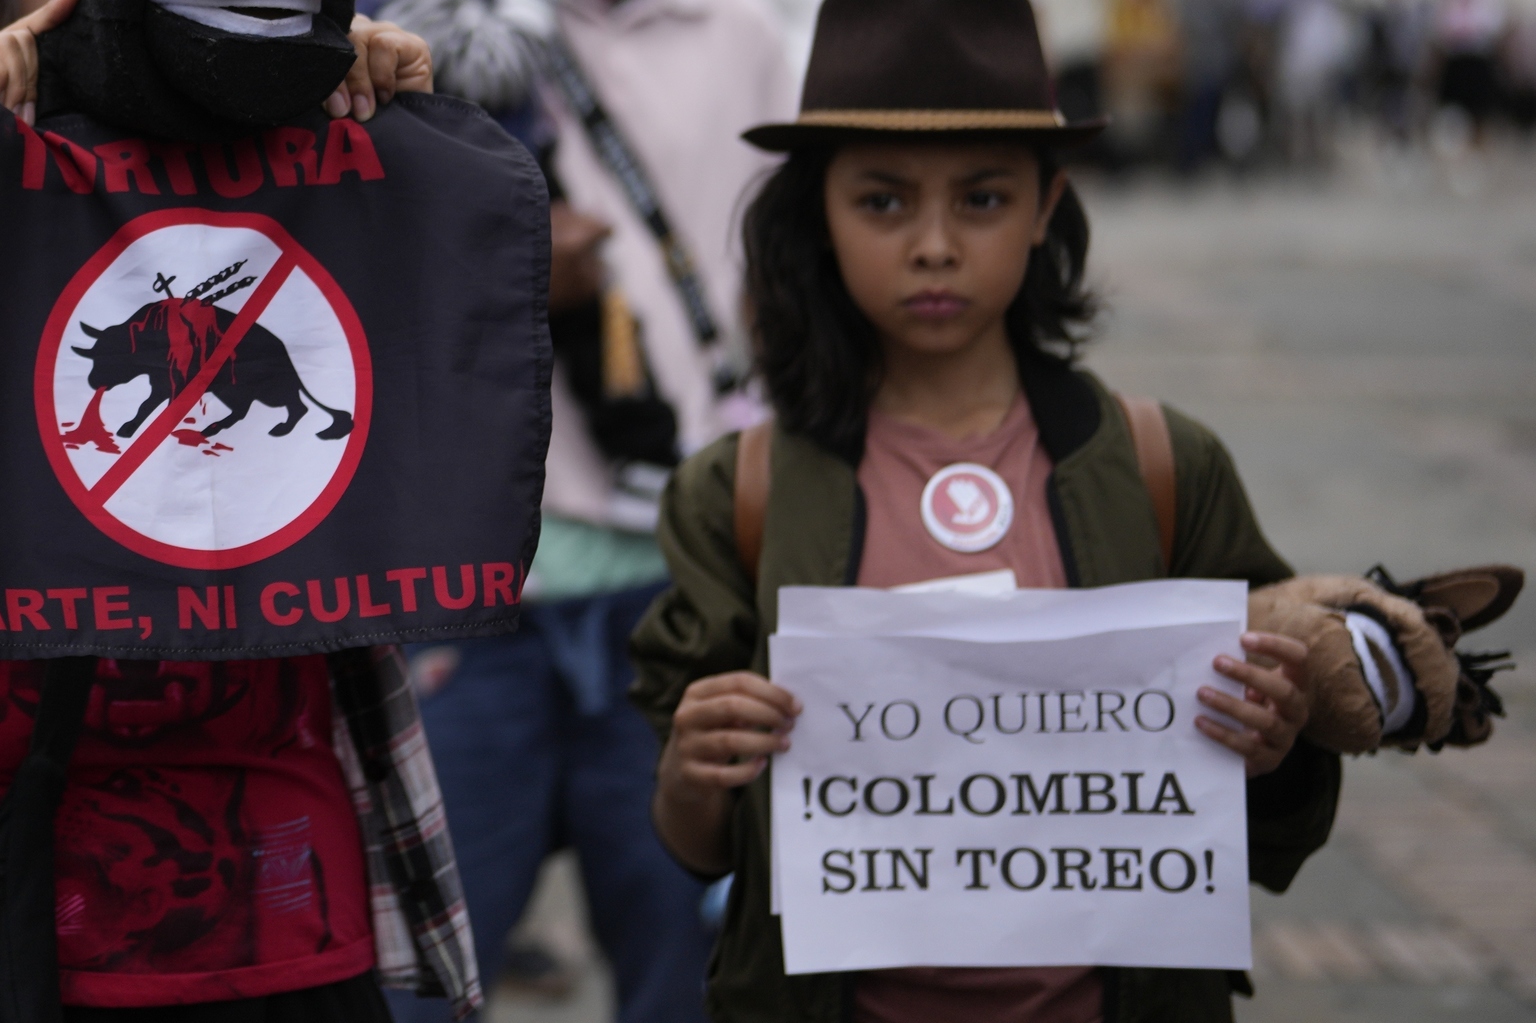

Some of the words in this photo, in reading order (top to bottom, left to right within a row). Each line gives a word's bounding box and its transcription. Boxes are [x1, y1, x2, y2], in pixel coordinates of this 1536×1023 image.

[177, 585, 237, 630] NI
[260, 561, 523, 626] CULTUR
[838, 700, 921, 742] YO
[943, 689, 1176, 743] QUIERO
[802, 771, 1196, 820] !COLOMBIA
[821, 848, 934, 894] SIN
[955, 846, 1216, 894] TOREO!
